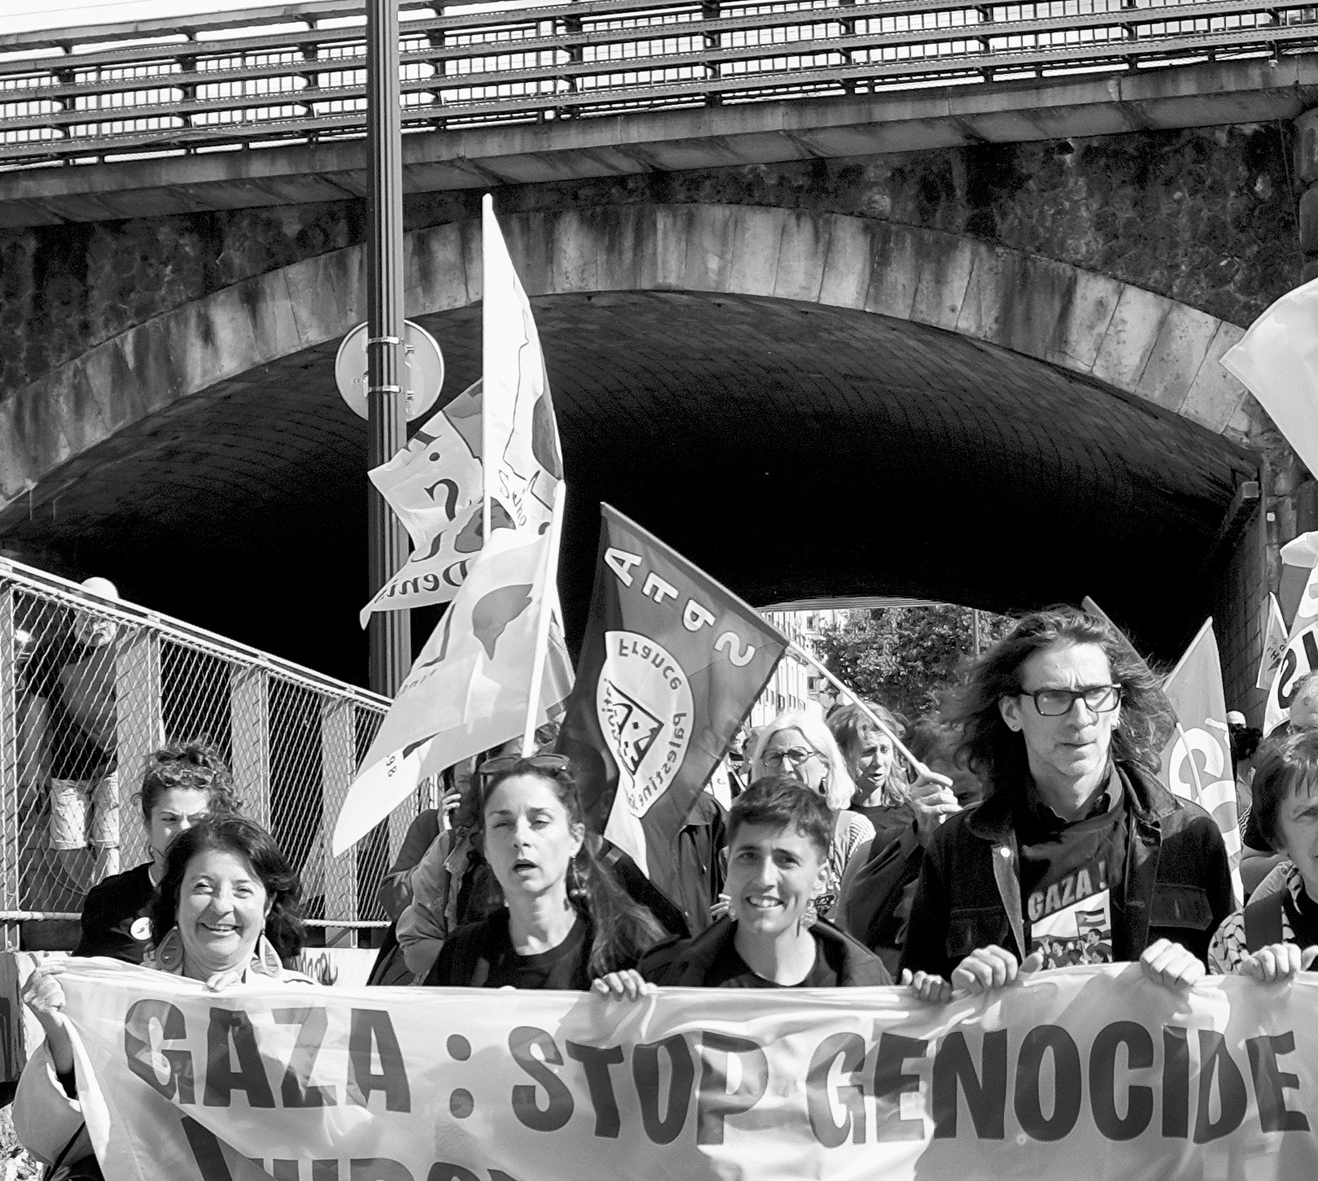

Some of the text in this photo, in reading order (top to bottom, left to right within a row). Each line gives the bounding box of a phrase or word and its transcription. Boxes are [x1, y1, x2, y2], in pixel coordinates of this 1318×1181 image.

[1027, 868, 1093, 921] GAZA
[124, 998, 411, 1113] GAZA
[508, 1025, 769, 1146] STOP
[806, 1020, 1311, 1148] GENOCIDE
